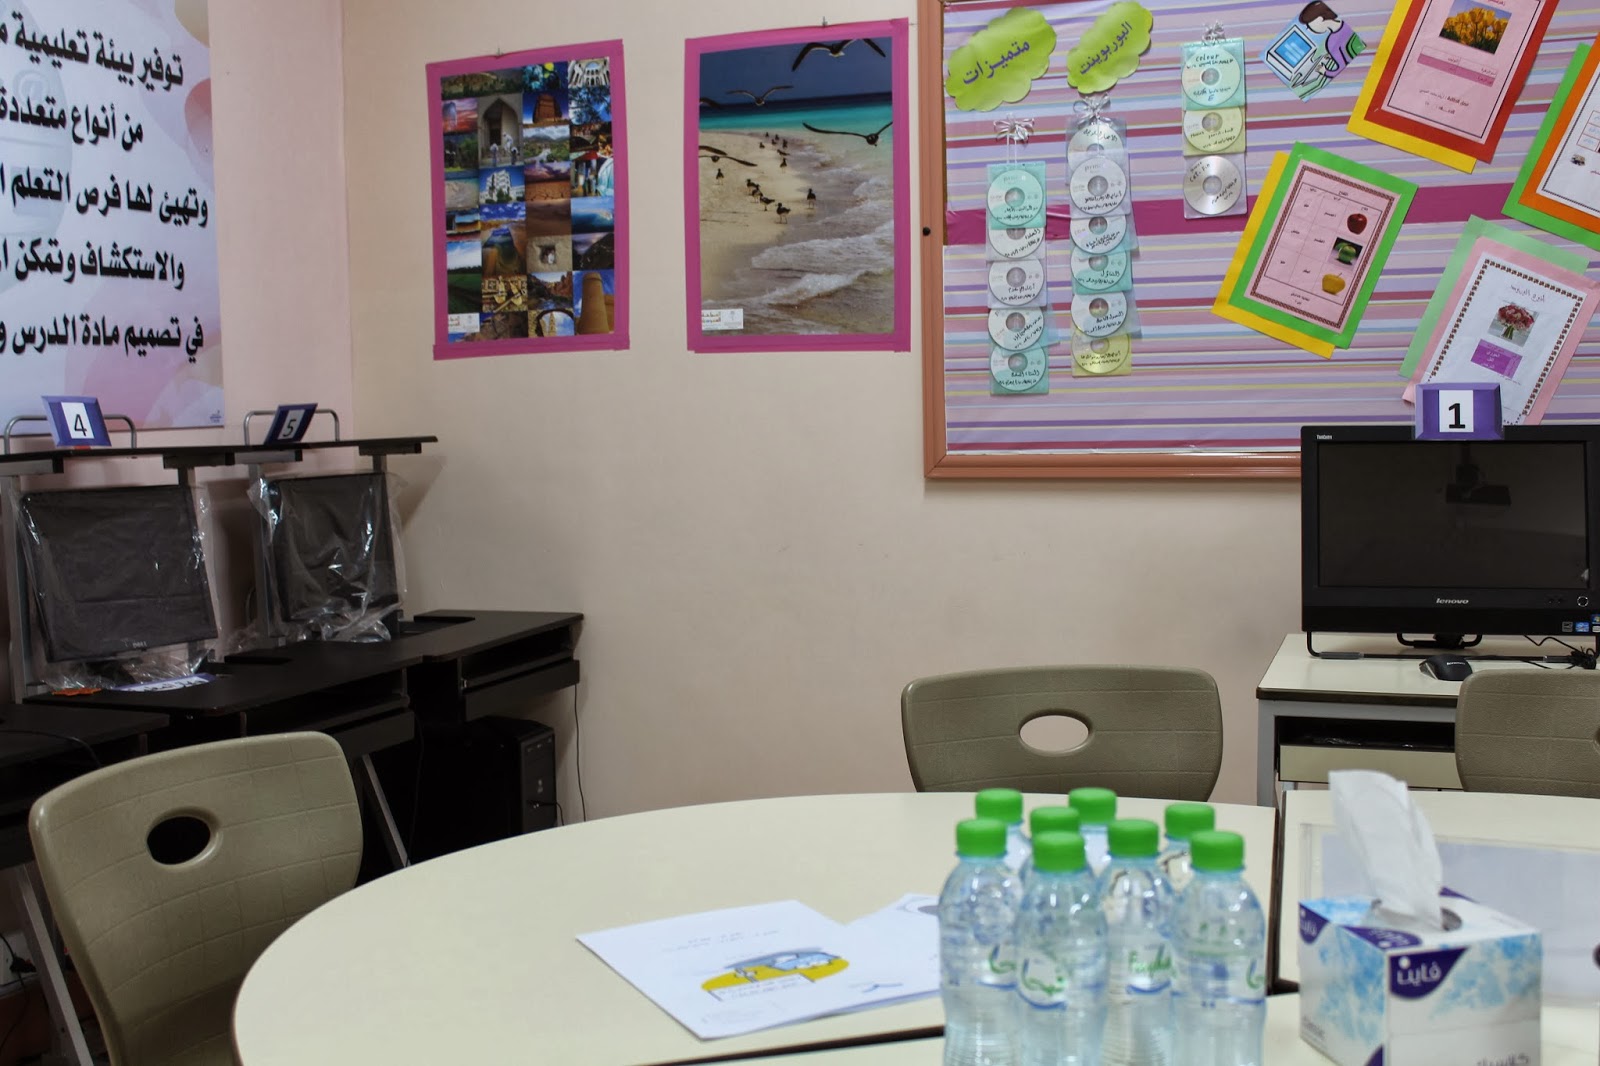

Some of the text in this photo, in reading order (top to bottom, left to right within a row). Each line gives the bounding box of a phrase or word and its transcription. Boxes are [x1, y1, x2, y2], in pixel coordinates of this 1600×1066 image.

[12, 11, 89, 69] تعليمية
[93, 31, 134, 86] بيئة
[137, 47, 183, 92] توفير
[963, 40, 1030, 85] متميزات
[0, 86, 143, 151] من أنواع متعددة
[12, 166, 71, 207] التعلم
[76, 174, 121, 216] فرص
[126, 180, 153, 212] لها
[15, 237, 76, 284] وتمكن
[80, 240, 185, 291] والاستكشاف
[12, 313, 78, 354] الدرس
[79, 313, 120, 345] مادة
[124, 316, 182, 357] تصميم
[185, 315, 204, 363] في
[73, 413, 87, 437] 4
[282, 418, 297, 437] 5
[1448, 402, 1466, 429] 1
[1436, 597, 1469, 605] lenovo
